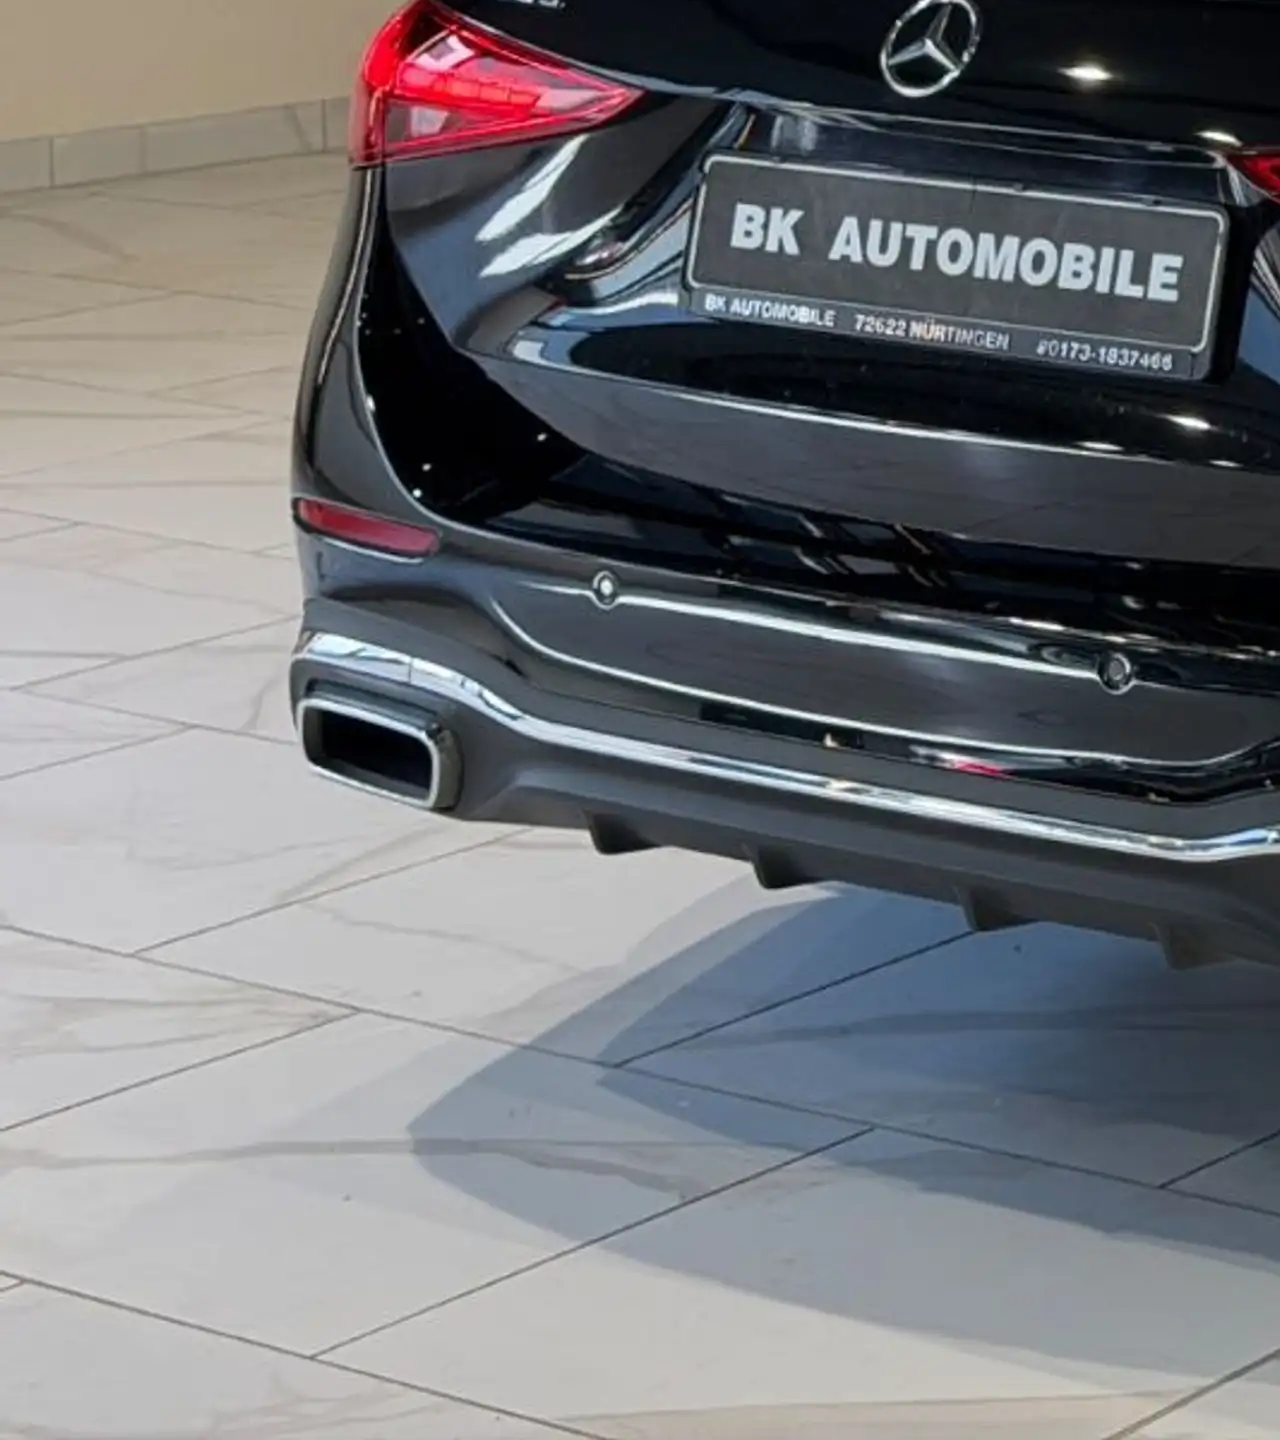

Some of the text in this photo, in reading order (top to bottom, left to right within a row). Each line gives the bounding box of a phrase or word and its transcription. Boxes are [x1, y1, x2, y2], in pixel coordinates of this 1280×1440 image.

[730, 203, 1185, 302] BK AUTOMOBILE
[705, 294, 727, 312] BK
[730, 298, 836, 327] AUTOMOBILE
[855, 314, 906, 337] 72622
[909, 317, 1009, 350] NÜRTINGEN
